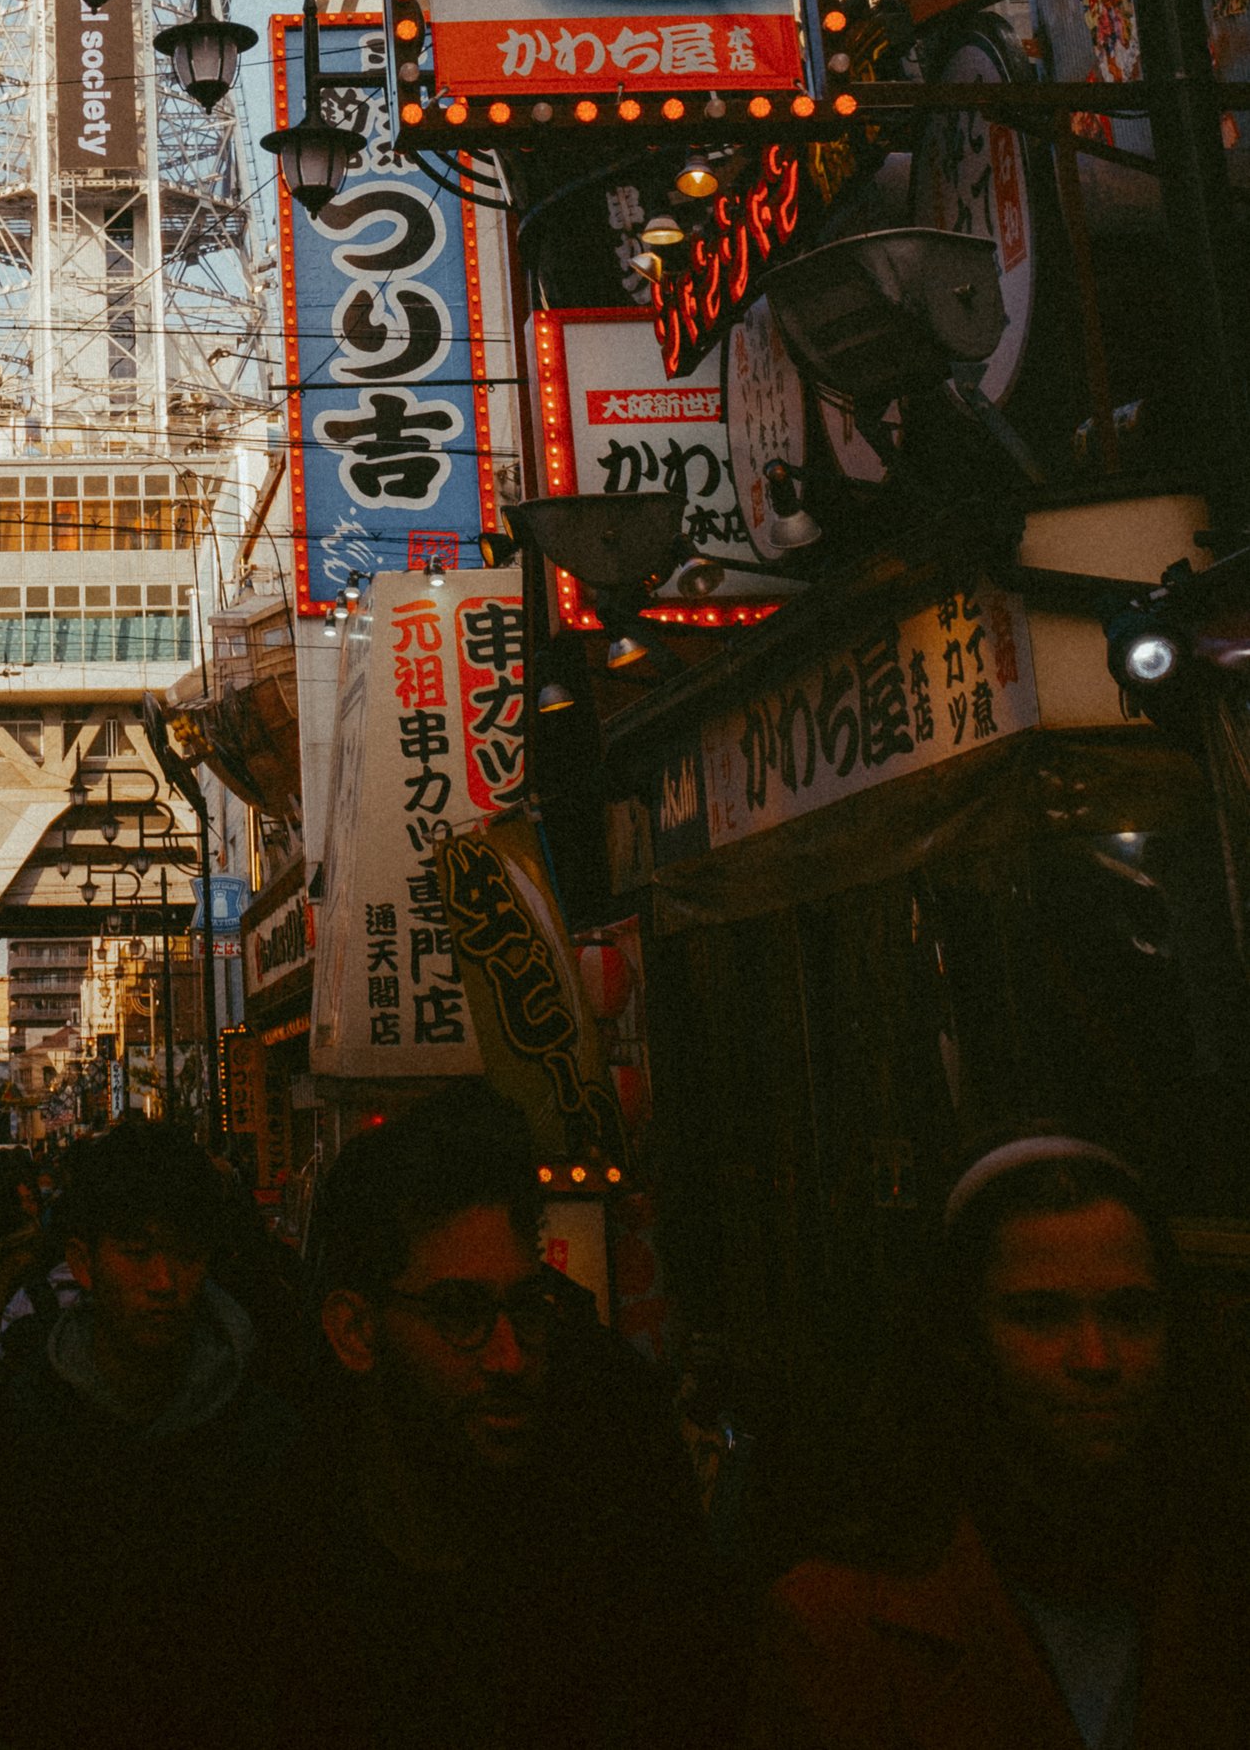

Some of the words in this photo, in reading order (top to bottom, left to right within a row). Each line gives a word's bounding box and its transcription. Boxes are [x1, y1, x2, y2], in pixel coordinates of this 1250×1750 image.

[78, 30, 112, 157] society
[497, 21, 719, 78] かわち屋
[727, 24, 757, 72] 本店
[310, 185, 460, 506] つり吉
[597, 437, 735, 498] かわ
[365, 903, 401, 1045] 通天閣店
